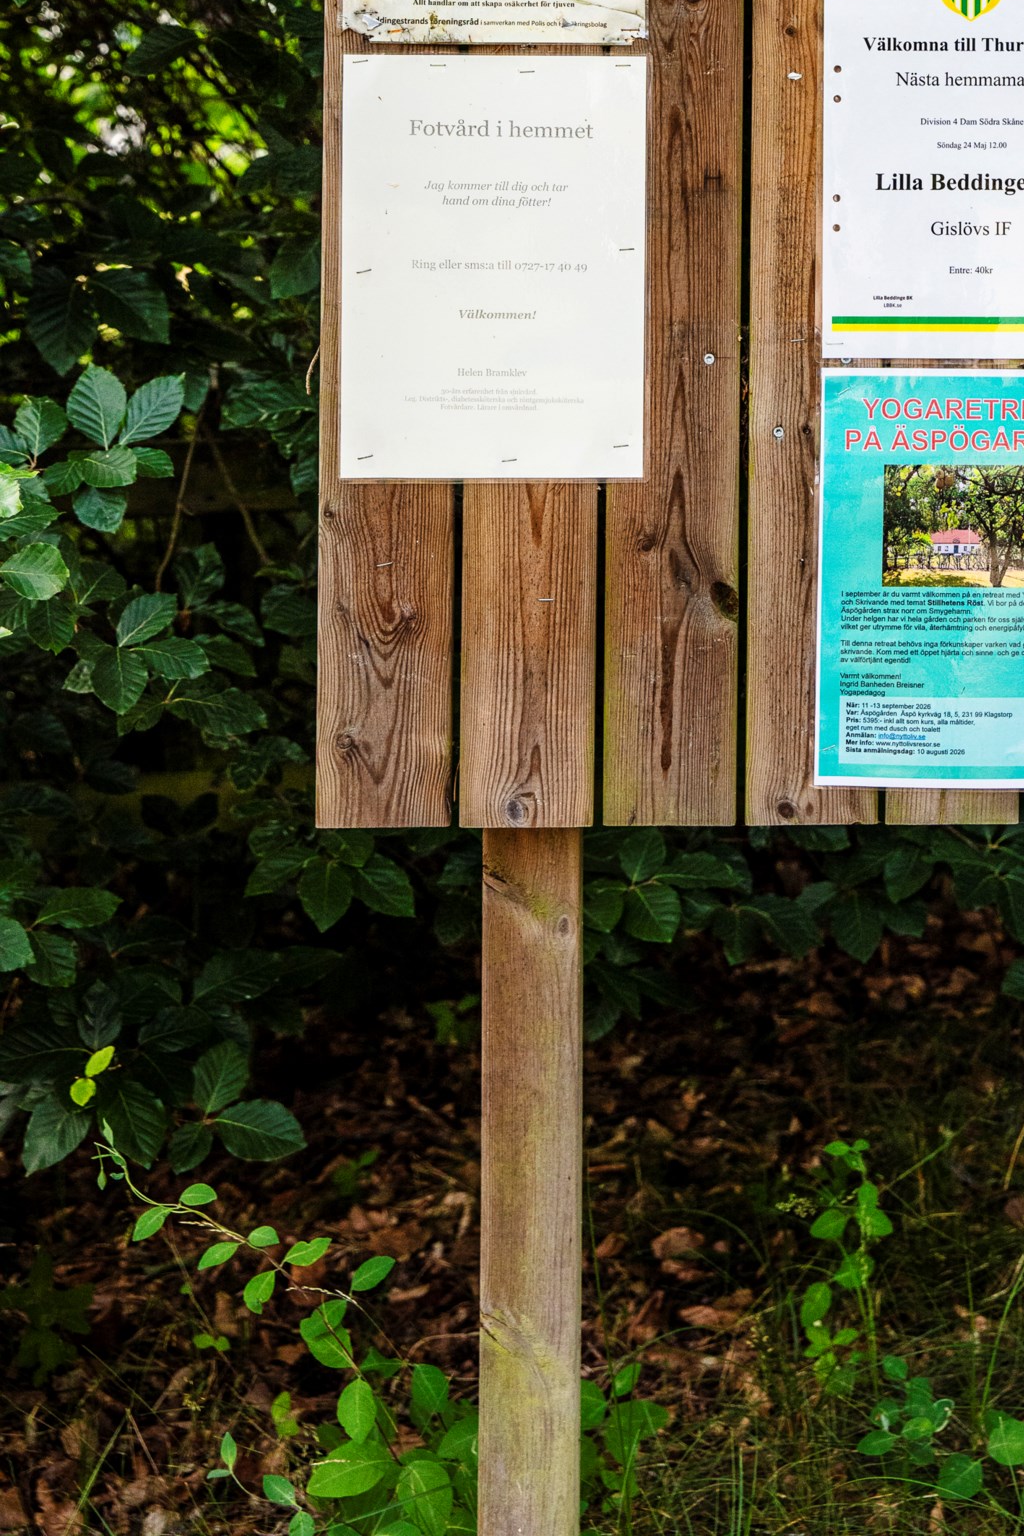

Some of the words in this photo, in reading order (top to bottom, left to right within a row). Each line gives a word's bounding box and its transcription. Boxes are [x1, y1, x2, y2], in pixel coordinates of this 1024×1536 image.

[864, 38, 948, 51] Välkomna
[955, 38, 975, 51] till
[896, 72, 939, 86] Nästa
[410, 119, 489, 137] Fotvård
[509, 119, 593, 138] hemmet
[937, 142, 961, 150] Söndag
[974, 142, 986, 150] Maj
[876, 173, 923, 190] Lilla
[931, 221, 989, 235] Gislövs
[996, 222, 1011, 235] IF
[950, 266, 972, 274] Entre:
[975, 266, 993, 274] 40kr
[459, 309, 536, 319] Välkommen!
[458, 368, 482, 376] Helen
[486, 368, 527, 376] Bramklev
[840, 681, 858, 689] Ingrid
[840, 689, 886, 697] Yogapedagog
